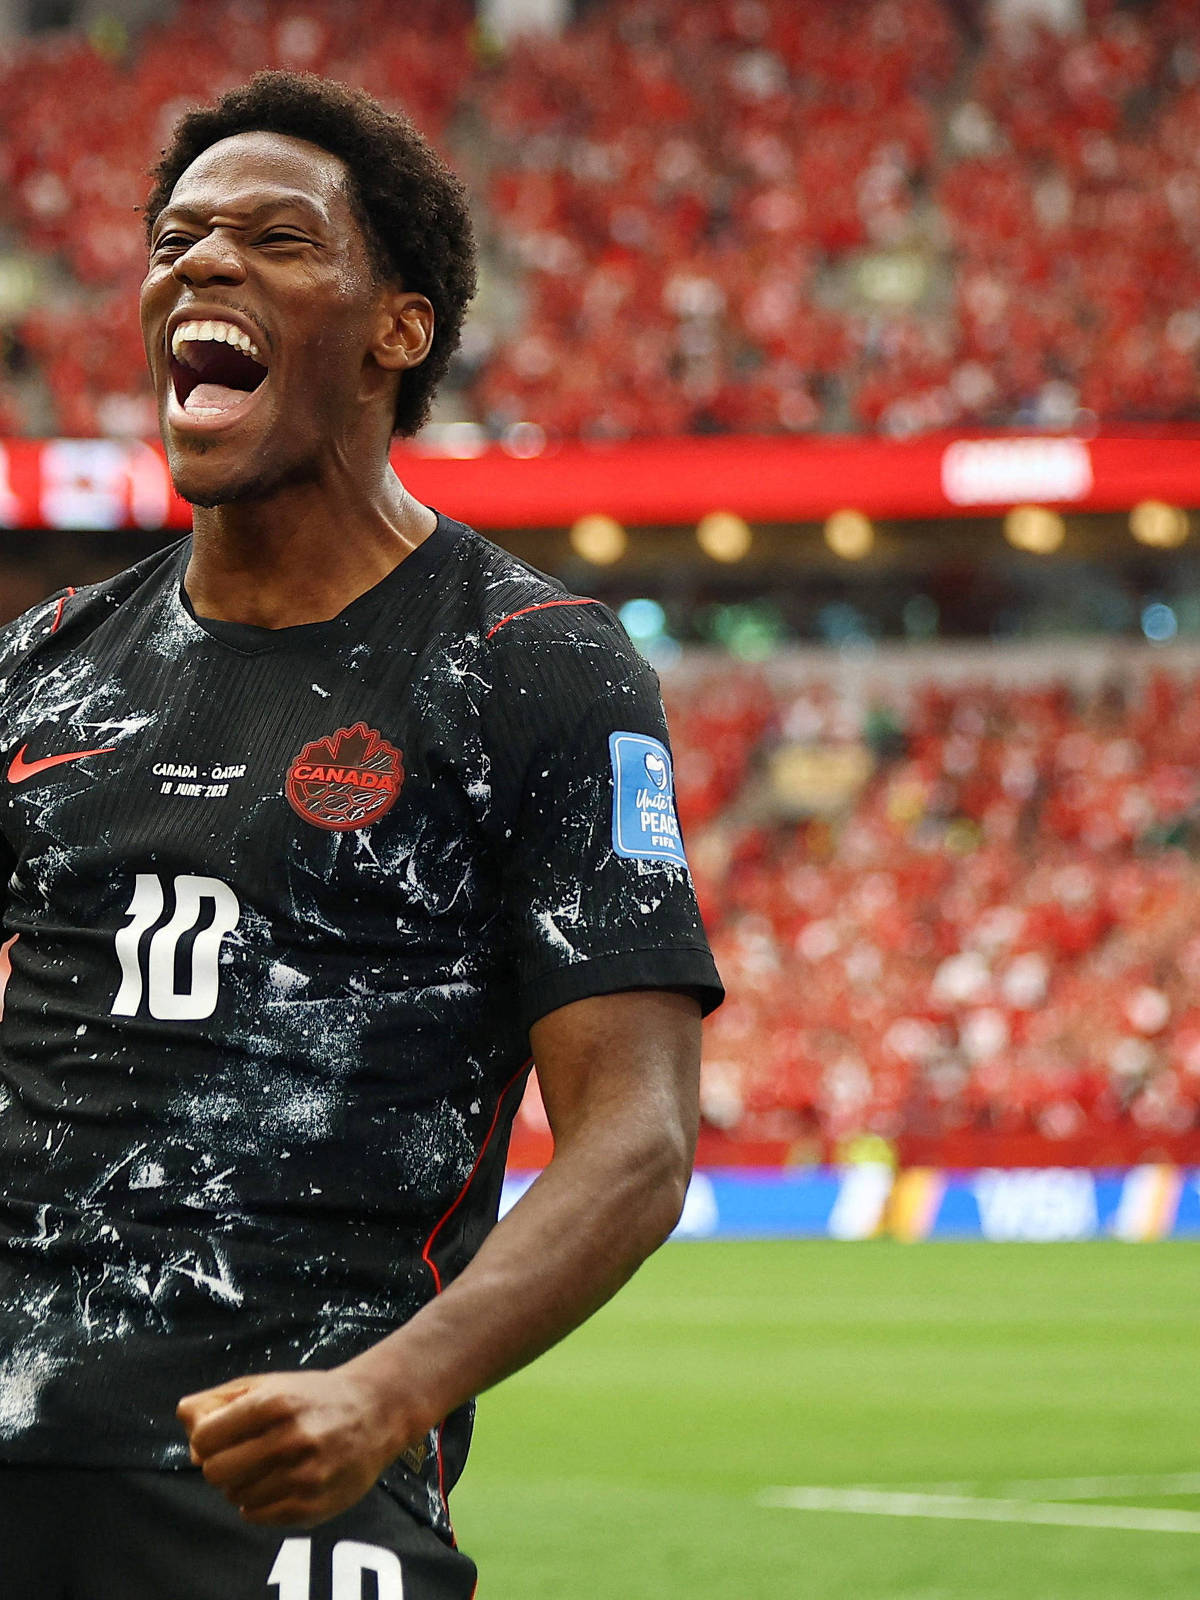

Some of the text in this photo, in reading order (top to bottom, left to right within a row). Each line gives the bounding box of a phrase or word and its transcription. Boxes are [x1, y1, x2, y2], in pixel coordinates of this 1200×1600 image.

[152, 763, 198, 778] CANADA
[211, 764, 247, 779] QATAR
[293, 765, 394, 792] CANADA
[160, 782, 173, 795] 18
[174, 783, 202, 797] JUNE
[652, 835, 676, 850] FIFA
[110, 873, 240, 1020] 10
